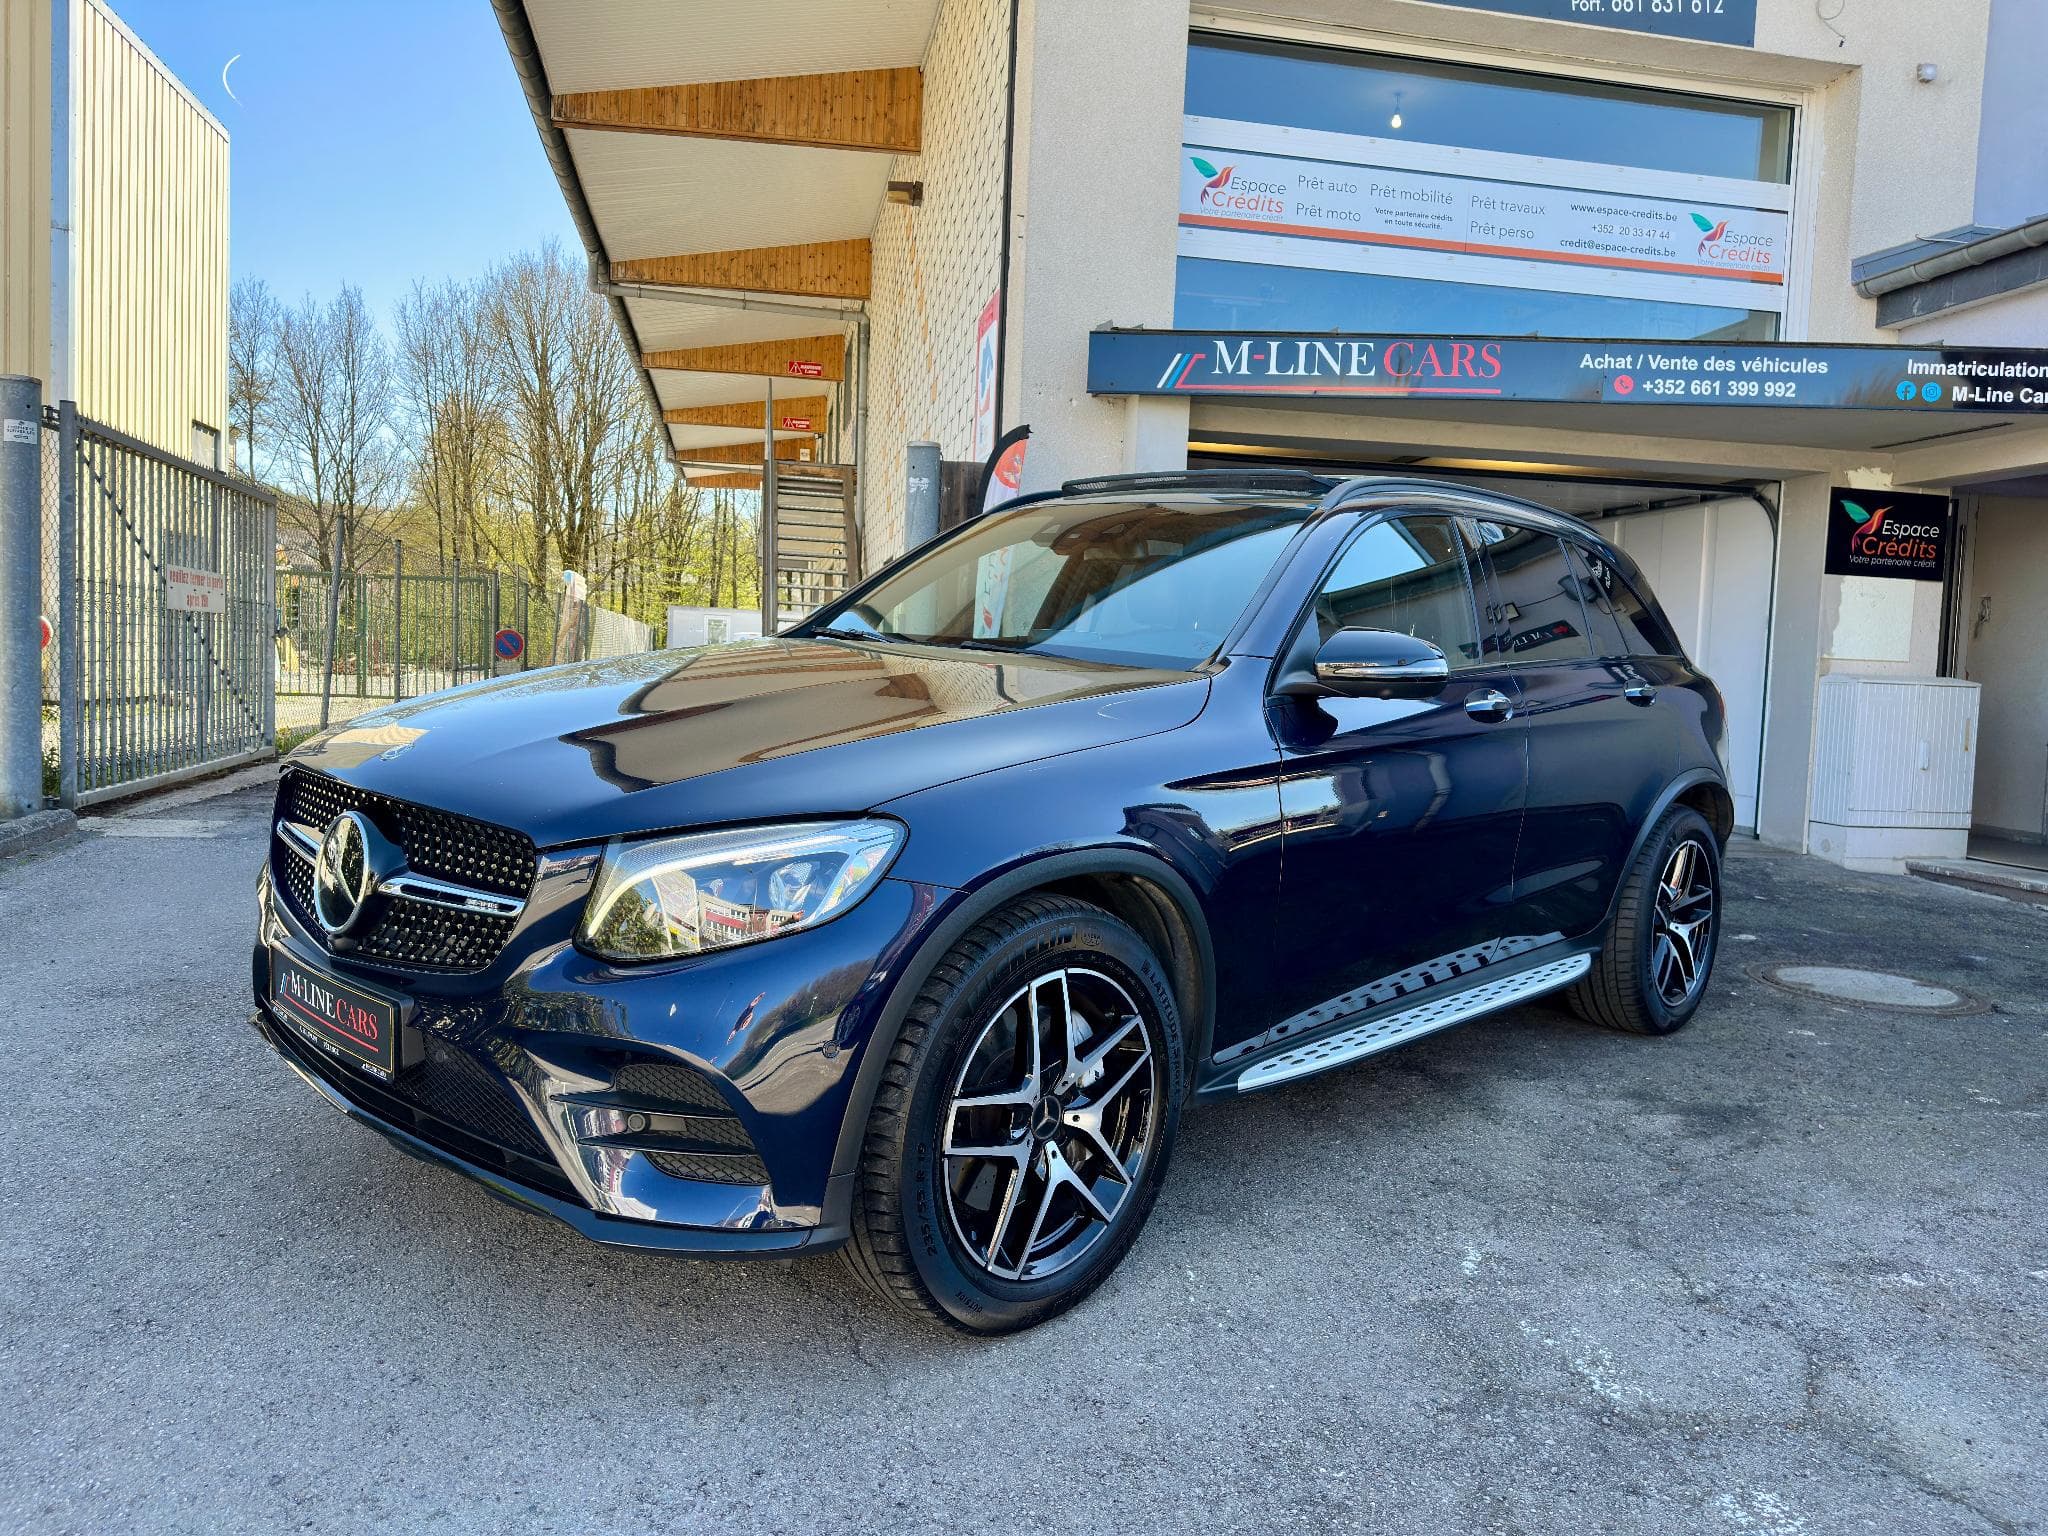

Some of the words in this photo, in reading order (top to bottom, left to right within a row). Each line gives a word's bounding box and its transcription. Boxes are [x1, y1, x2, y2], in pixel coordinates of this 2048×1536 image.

[1691, 0, 1724, 14] 612
[1230, 176, 1287, 195] Espace
[1298, 174, 1325, 190] Prêt
[1328, 181, 1358, 194] auto
[1370, 183, 1397, 199] Prêt
[1400, 188, 1454, 205] mobilité
[1212, 191, 1284, 214] Crédits
[1296, 202, 1323, 218] Prêt
[1326, 208, 1361, 222] moto
[1471, 195, 1497, 210] Prêt
[1500, 199, 1545, 215] travaux
[1570, 202, 1678, 222] www.espace-credits.be
[1375, 206, 1394, 216] Votre
[1395, 209, 1430, 220] partenaire
[1394, 218, 1413, 227] toute
[1470, 220, 1496, 236] Prêt
[1499, 226, 1535, 240] perso
[1591, 223, 1614, 235] +352
[1618, 225, 1630, 236] 20
[1632, 226, 1644, 237] 33
[1645, 228, 1657, 239] 47
[1659, 230, 1671, 240] 44
[1724, 230, 1774, 246] Espace
[1559, 238, 1676, 258] credit@espace-credits.be
[1708, 244, 1771, 264] Crédits
[1210, 340, 1376, 377] M-LINE
[1383, 342, 1502, 378] CARS
[1579, 353, 1633, 370] Achat
[1636, 353, 1643, 370] /
[1648, 354, 1699, 371] Vente
[1703, 355, 1736, 372] des
[1741, 356, 1829, 374] véhicules
[1907, 358, 2048, 378] Immatriculation
[1642, 379, 1685, 396] +352
[1690, 380, 1721, 396] 661
[1727, 381, 1759, 397] 399
[1764, 381, 1797, 398] 992
[1951, 385, 2014, 403] M-Line
[1882, 519, 1940, 539] Espace
[1862, 537, 1937, 559] Crédits
[1849, 554, 1870, 564] Votre
[1870, 556, 1912, 567] partenaire
[291, 969, 336, 1019] M-LINE
[336, 998, 379, 1040] CARS
